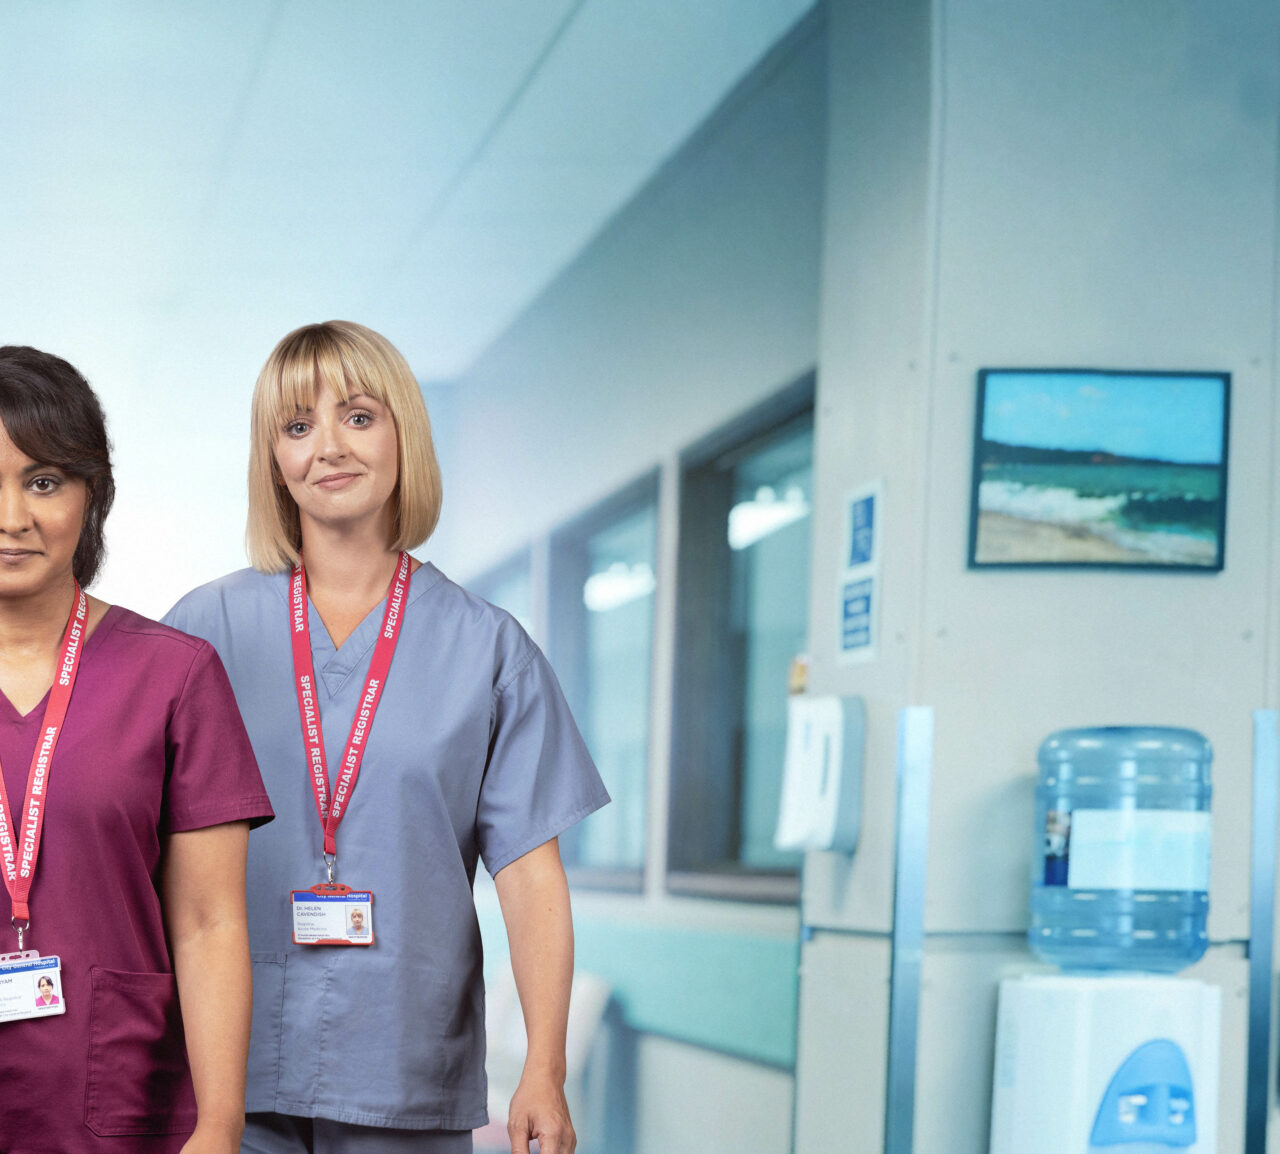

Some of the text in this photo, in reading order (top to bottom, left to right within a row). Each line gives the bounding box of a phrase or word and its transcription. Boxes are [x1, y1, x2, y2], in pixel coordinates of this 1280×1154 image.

[293, 574, 304, 633] REGISTRAR
[384, 581, 405, 639] SPECIALIST
[59, 620, 83, 686] SPECIALIST
[300, 675, 319, 744] SPECIALIST
[332, 679, 380, 818] SPECIALIST REGISTRAR
[20, 726, 58, 878] SPECIALIST REGISTRAR
